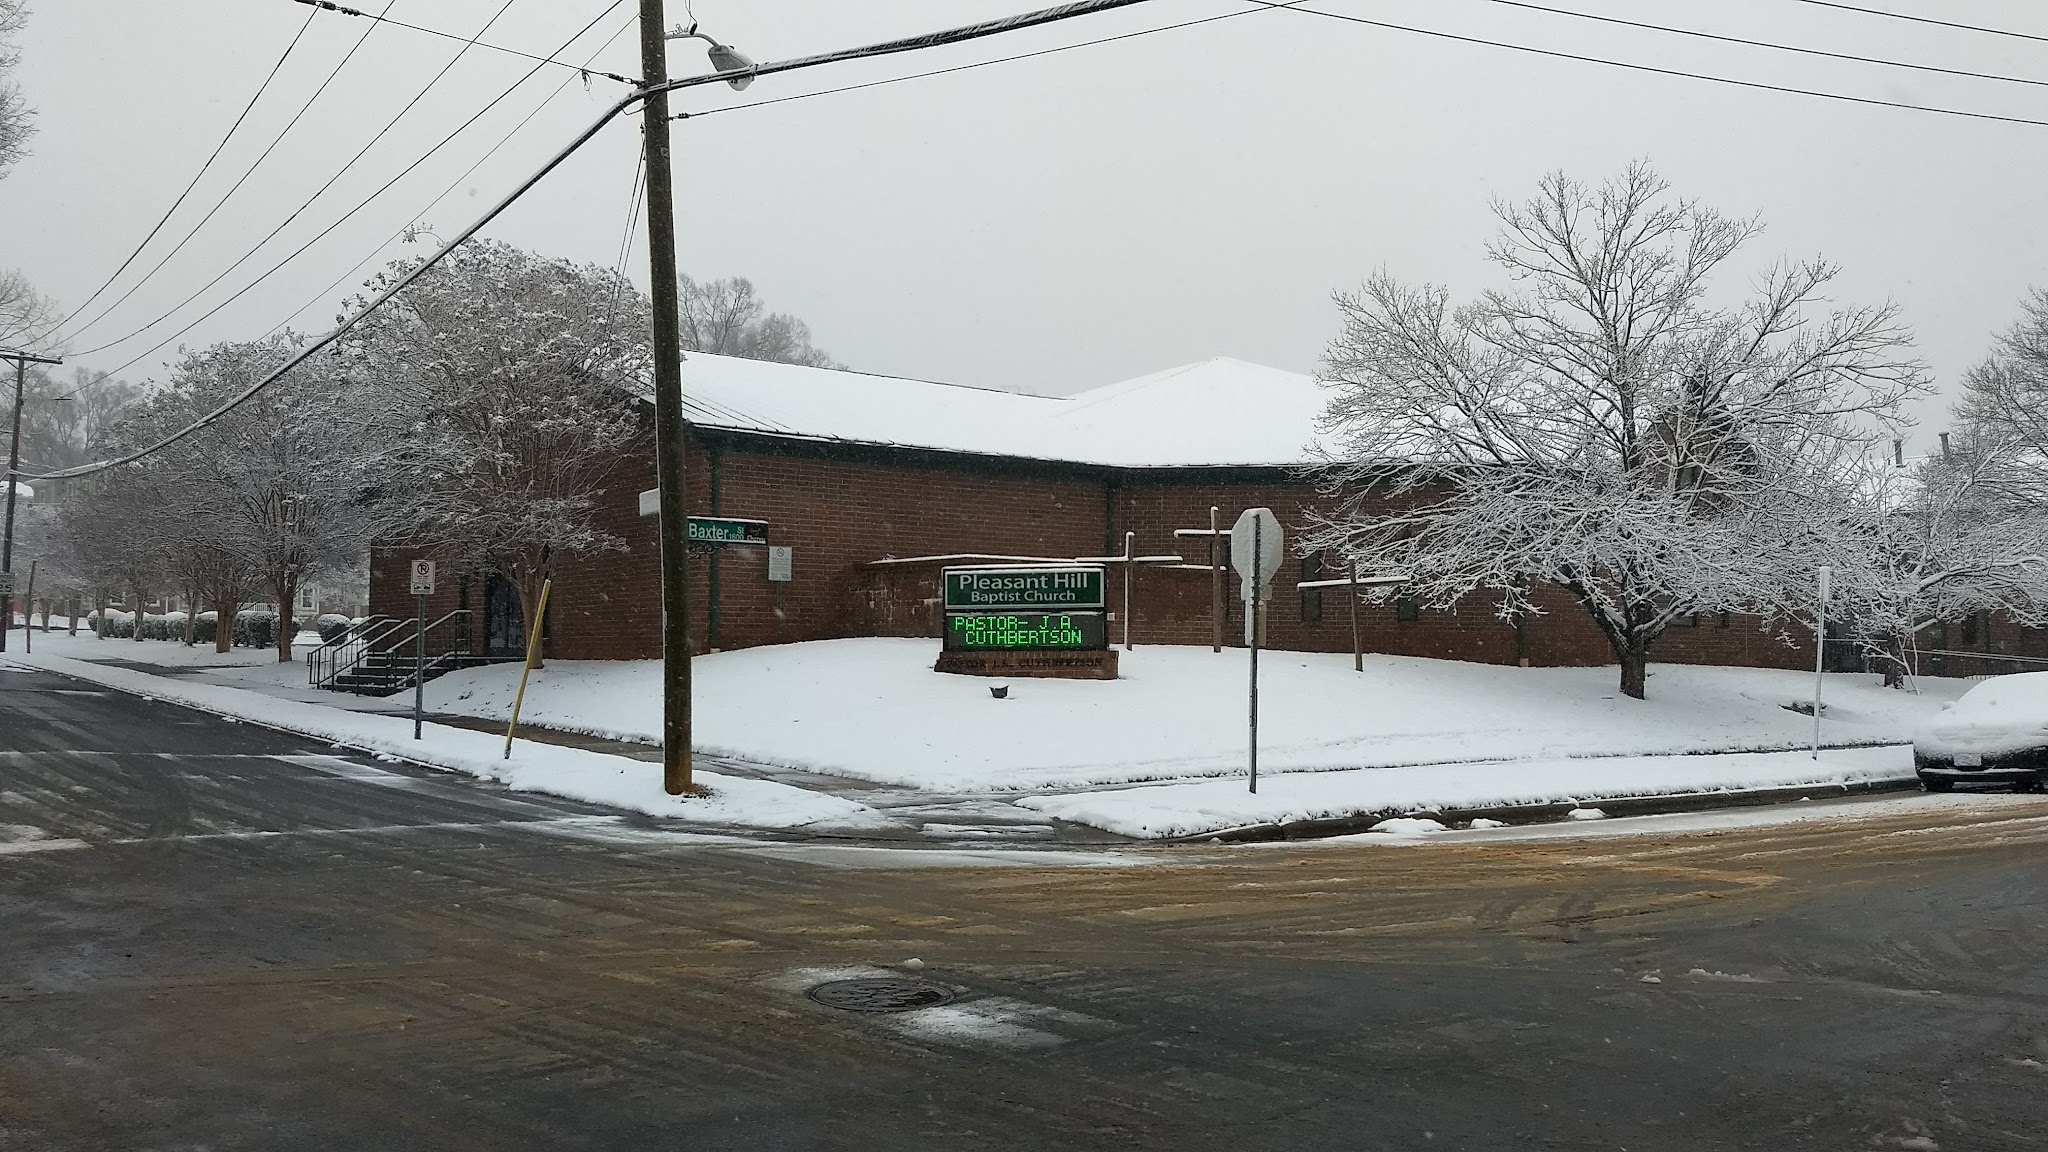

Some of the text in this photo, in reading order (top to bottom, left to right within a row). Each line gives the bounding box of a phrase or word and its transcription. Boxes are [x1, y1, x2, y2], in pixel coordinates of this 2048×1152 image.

[689, 523, 745, 540] Baxter St
[729, 533, 745, 541] 1600
[959, 572, 1088, 590] Pleasant Hill
[971, 590, 1076, 604] Baptist Church
[954, 616, 1029, 631] PASTOR-
[965, 629, 1082, 645] CUTHBERTSON
